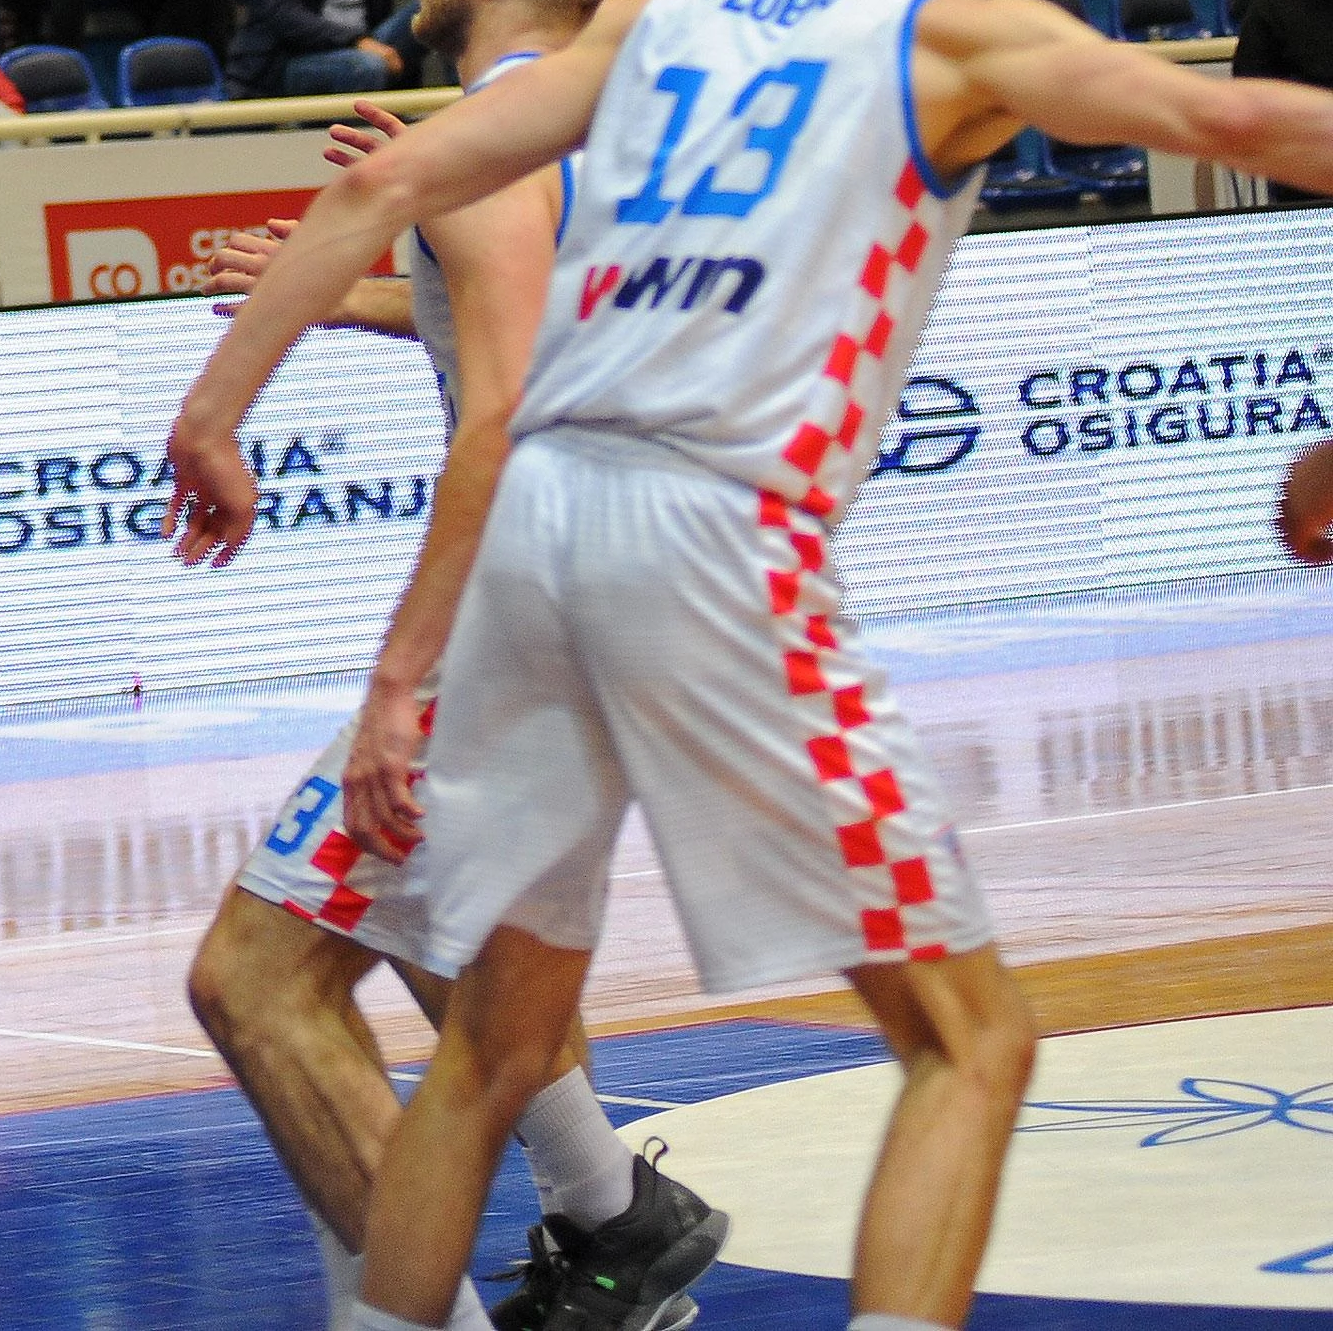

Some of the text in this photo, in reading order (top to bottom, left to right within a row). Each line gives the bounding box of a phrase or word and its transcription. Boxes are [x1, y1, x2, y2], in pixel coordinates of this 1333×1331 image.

[615, 60, 831, 226] 13
[1018, 349, 1314, 410] CROATIA
[1021, 392, 1332, 456] OSIGURA
[265, 775, 341, 857] 3
